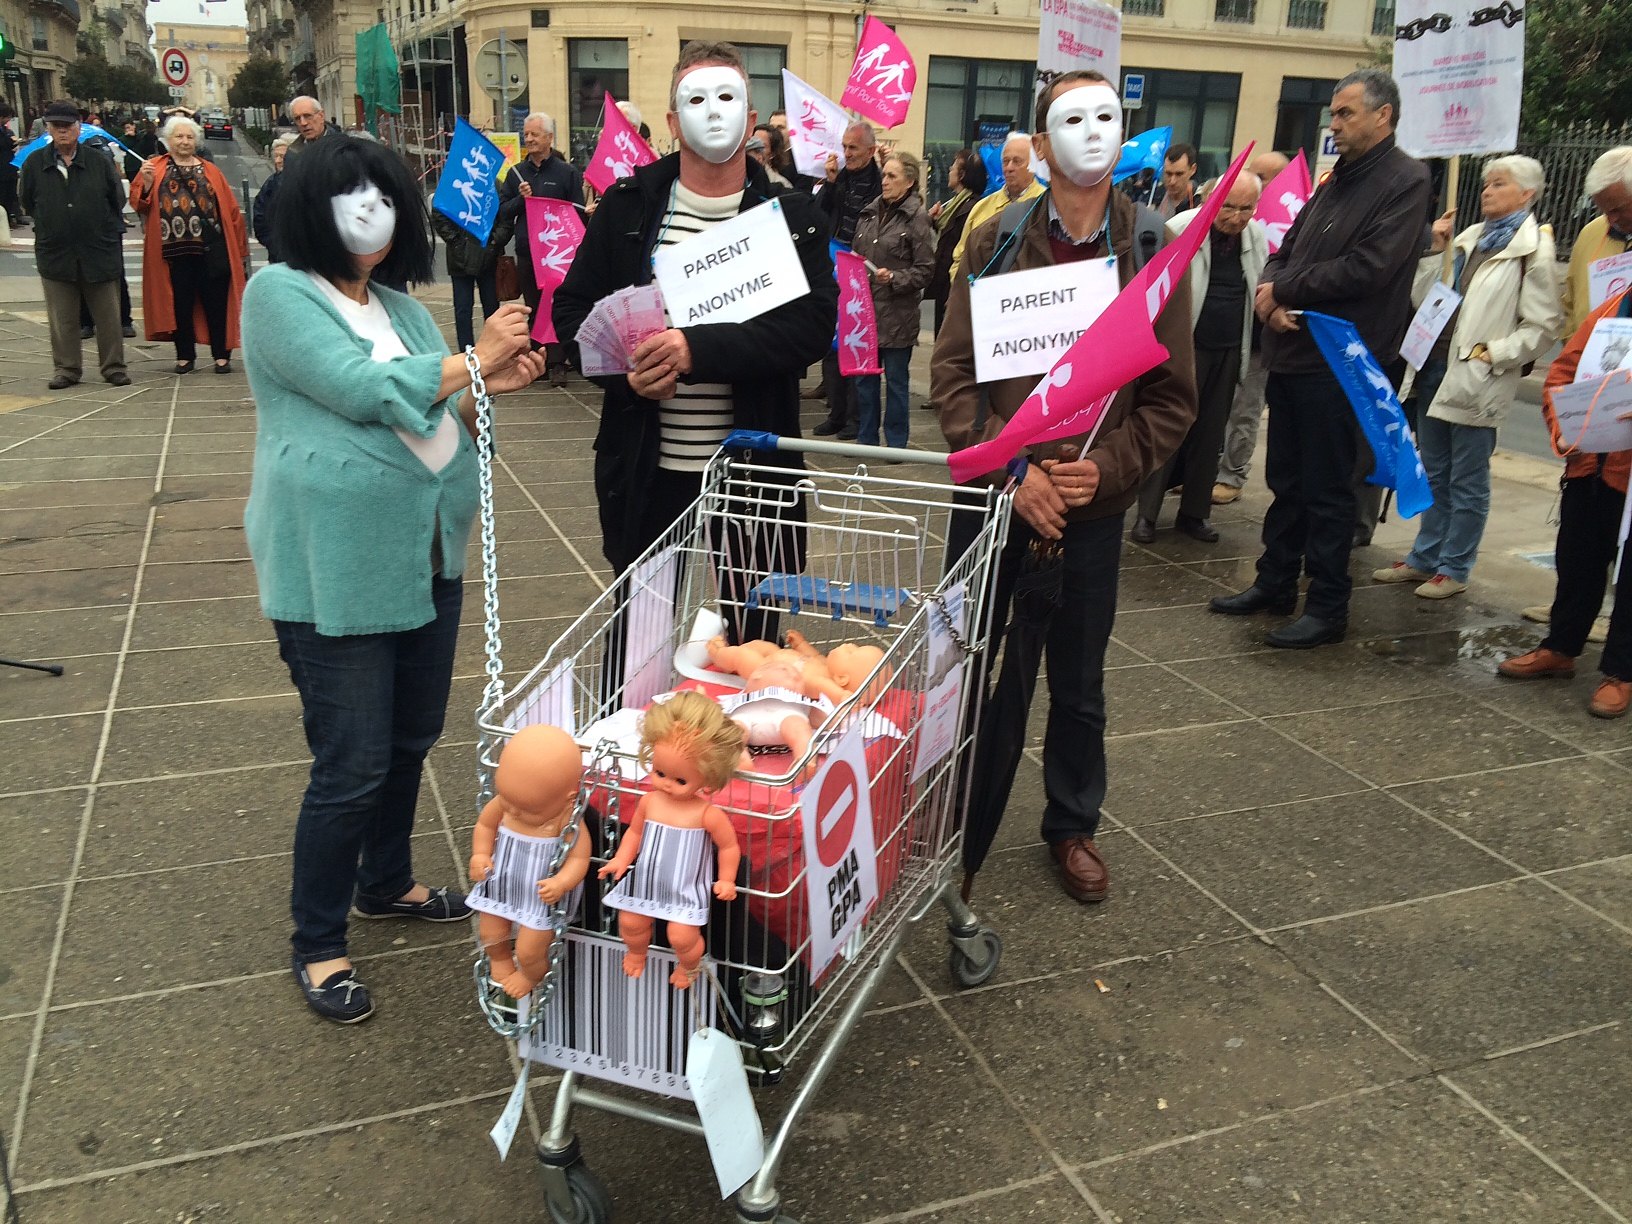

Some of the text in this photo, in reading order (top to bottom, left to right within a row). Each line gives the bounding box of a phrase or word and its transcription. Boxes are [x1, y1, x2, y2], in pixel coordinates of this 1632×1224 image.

[857, 88, 876, 104] Pour
[876, 99, 895, 117] Tous
[683, 236, 751, 279] PARENT
[688, 272, 774, 322] ANONYME
[1001, 286, 1078, 313] PARENT
[827, 848, 860, 909] PMA
[831, 877, 862, 939] GPA
